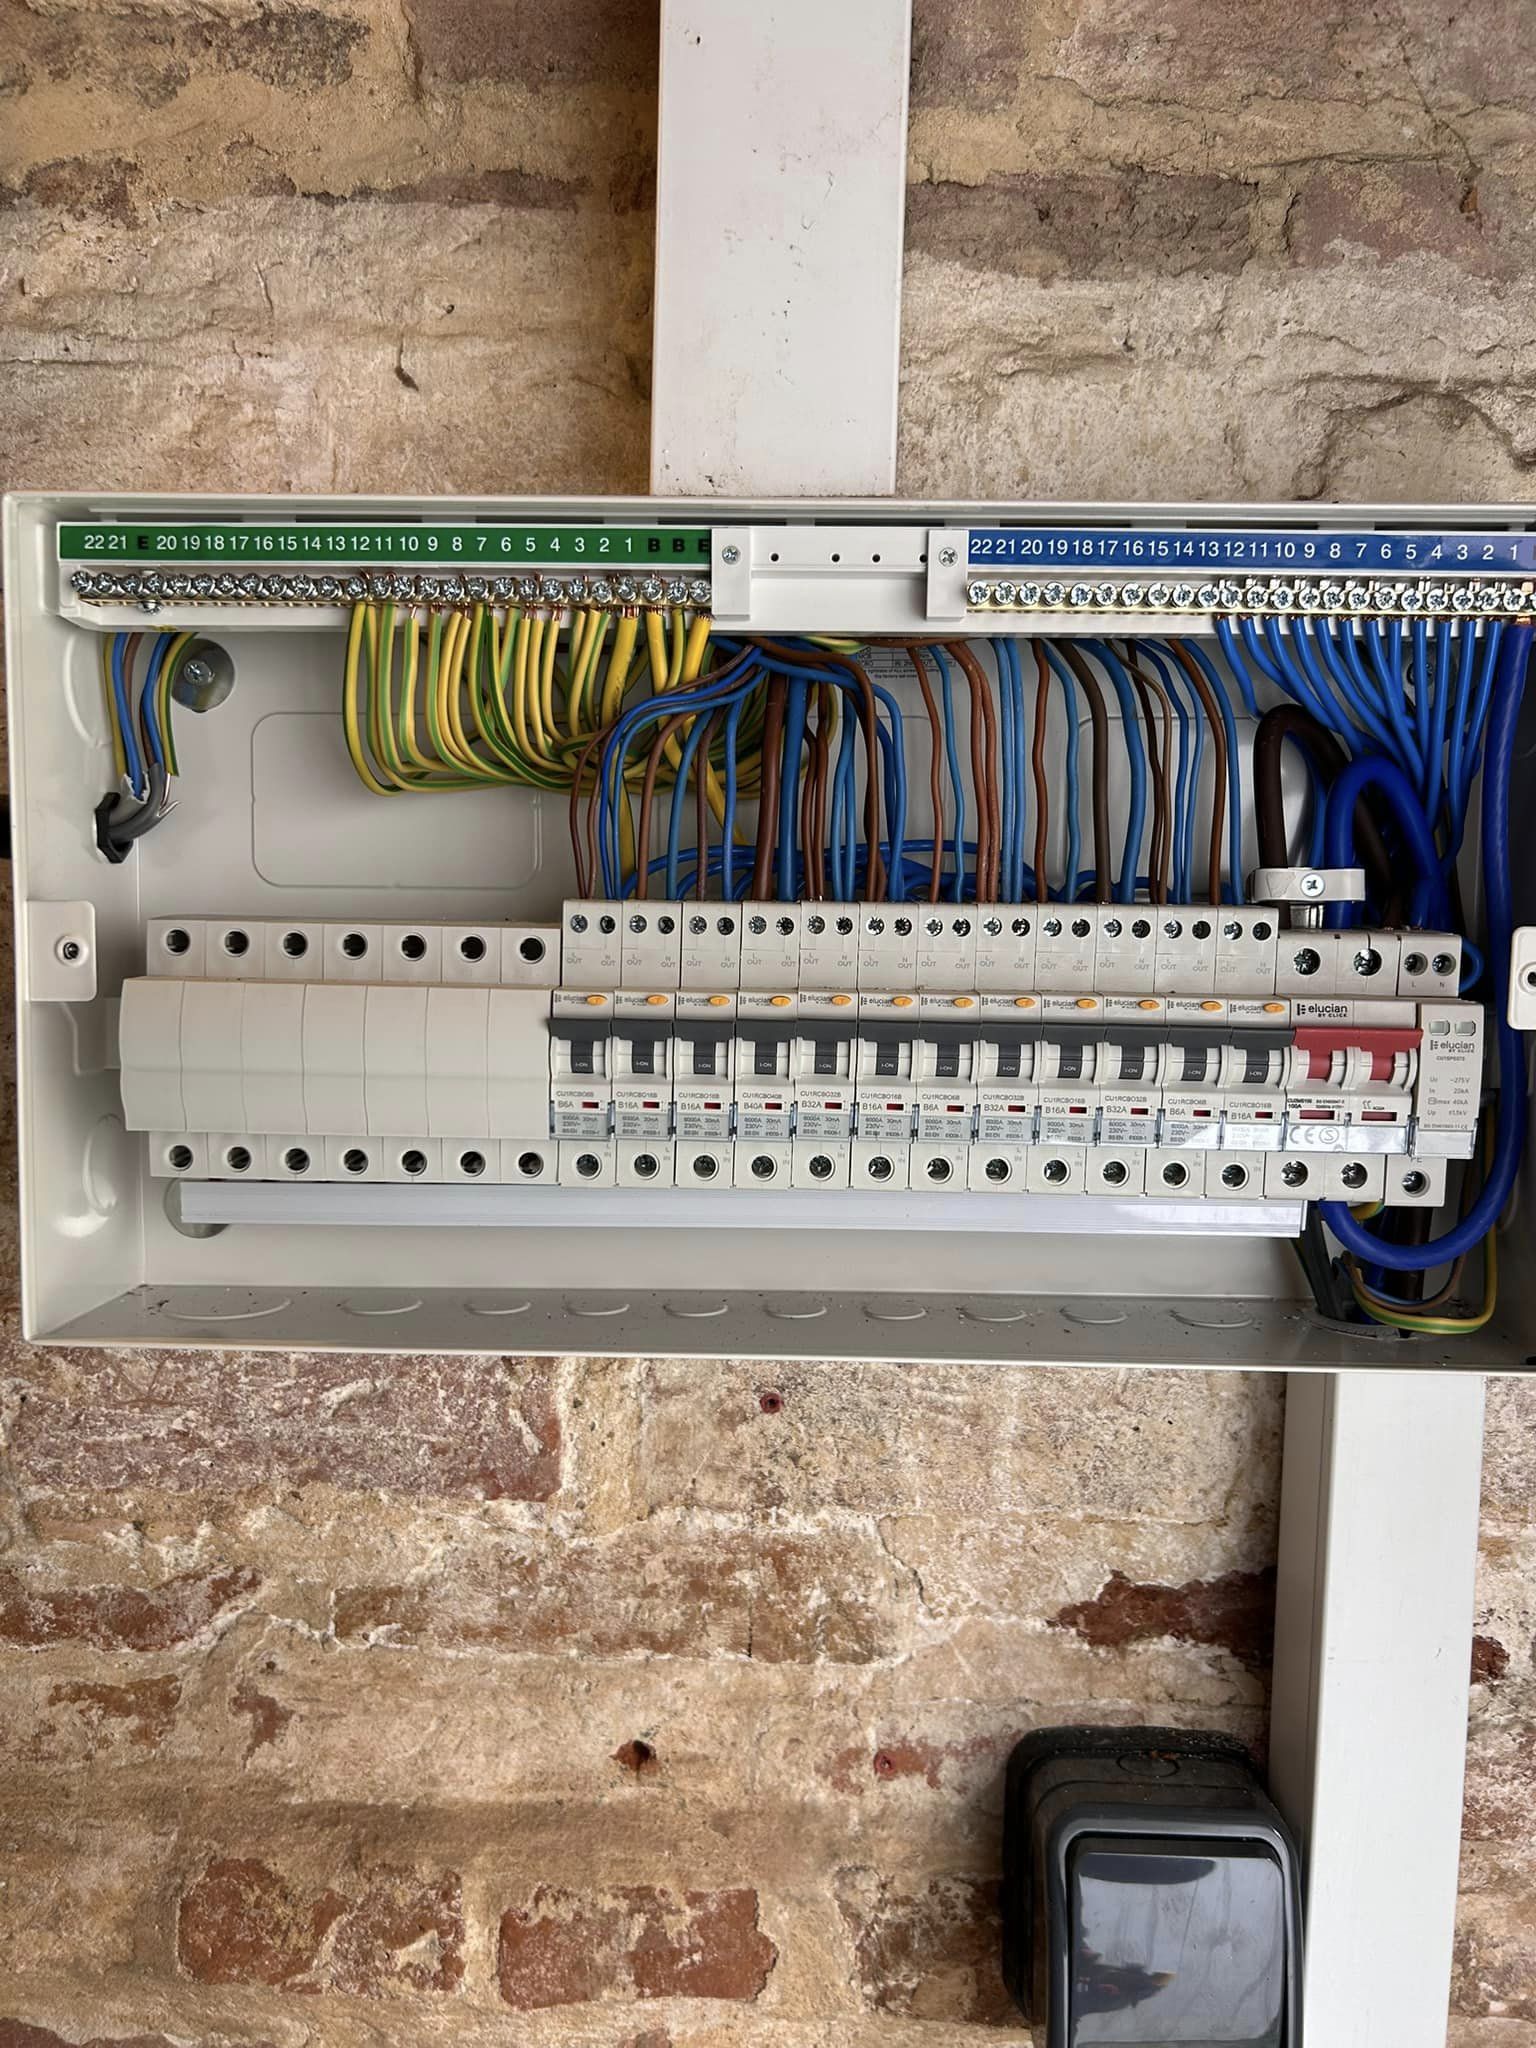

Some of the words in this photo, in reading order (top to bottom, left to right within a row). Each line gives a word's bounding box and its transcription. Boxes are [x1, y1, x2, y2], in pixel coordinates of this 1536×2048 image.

[85, 535, 104, 549] 22
[109, 535, 126, 549] 21
[138, 537, 148, 549] E
[157, 536, 176, 550] 20
[182, 536, 200, 550] 19
[205, 536, 224, 550] 18
[230, 536, 248, 550] 17
[254, 536, 273, 550] 16
[278, 536, 297, 550] 15
[303, 536, 321, 550] 14
[327, 536, 345, 550] 13
[351, 536, 369, 550] 12
[376, 536, 391, 550] 11
[400, 537, 418, 551] 10
[428, 537, 437, 551] 9
[453, 537, 462, 551] 8
[477, 537, 487, 551] 7
[501, 537, 511, 551] 6
[526, 538, 535, 552] 5
[550, 538, 560, 551] 4
[575, 537, 584, 552] 3
[600, 538, 609, 552] 2
[626, 538, 631, 552] 1
[648, 538, 660, 552] B
[673, 538, 684, 552] B
[970, 539, 992, 555] 22
[996, 539, 1014, 554] 21
[1021, 539, 1042, 554] 20
[1048, 539, 1068, 555] 19
[1073, 540, 1093, 555] 18
[1098, 540, 1118, 555] 17
[1123, 540, 1143, 555] 16
[1148, 541, 1168, 556] 15
[1174, 541, 1194, 556] 14
[1199, 541, 1219, 556] 13
[1224, 542, 1244, 557] 12
[1250, 542, 1267, 557] 11
[1275, 542, 1295, 558] 10
[1304, 543, 1315, 558] 9
[1330, 543, 1340, 558] 8
[1356, 543, 1367, 558] 7
[1381, 544, 1391, 559] 6
[1406, 544, 1416, 559] 5
[1431, 544, 1442, 559] 4
[1457, 544, 1467, 560] 3
[1483, 544, 1494, 559] 2
[1511, 545, 1517, 560] 1
[1309, 1004, 1347, 1013] elucian
[1440, 1041, 1474, 1049] elucian
